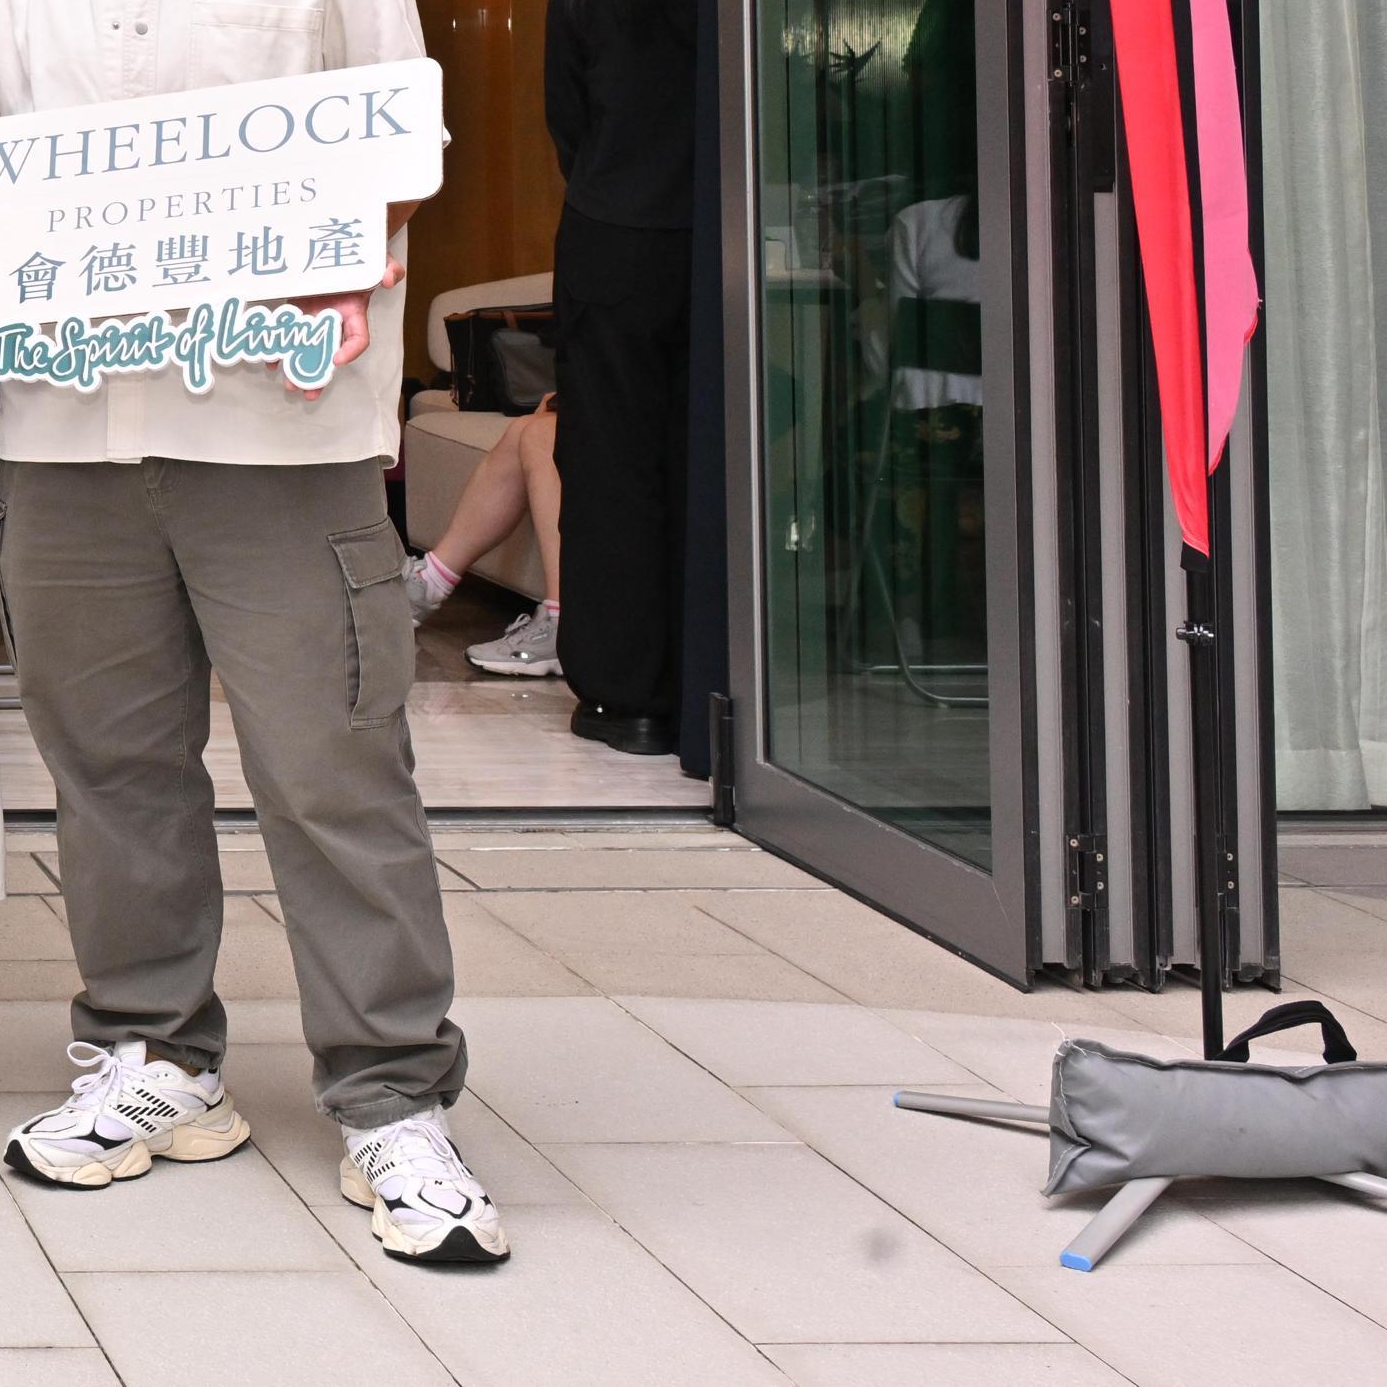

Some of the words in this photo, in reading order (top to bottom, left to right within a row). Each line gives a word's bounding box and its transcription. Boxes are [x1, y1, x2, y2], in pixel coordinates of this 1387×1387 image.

[47, 177, 318, 233] PROPERTIES
[8, 218, 366, 304] 會德豐地產
[51, 315, 175, 387] Spirit
[174, 303, 215, 388] of
[217, 297, 336, 380] Living
